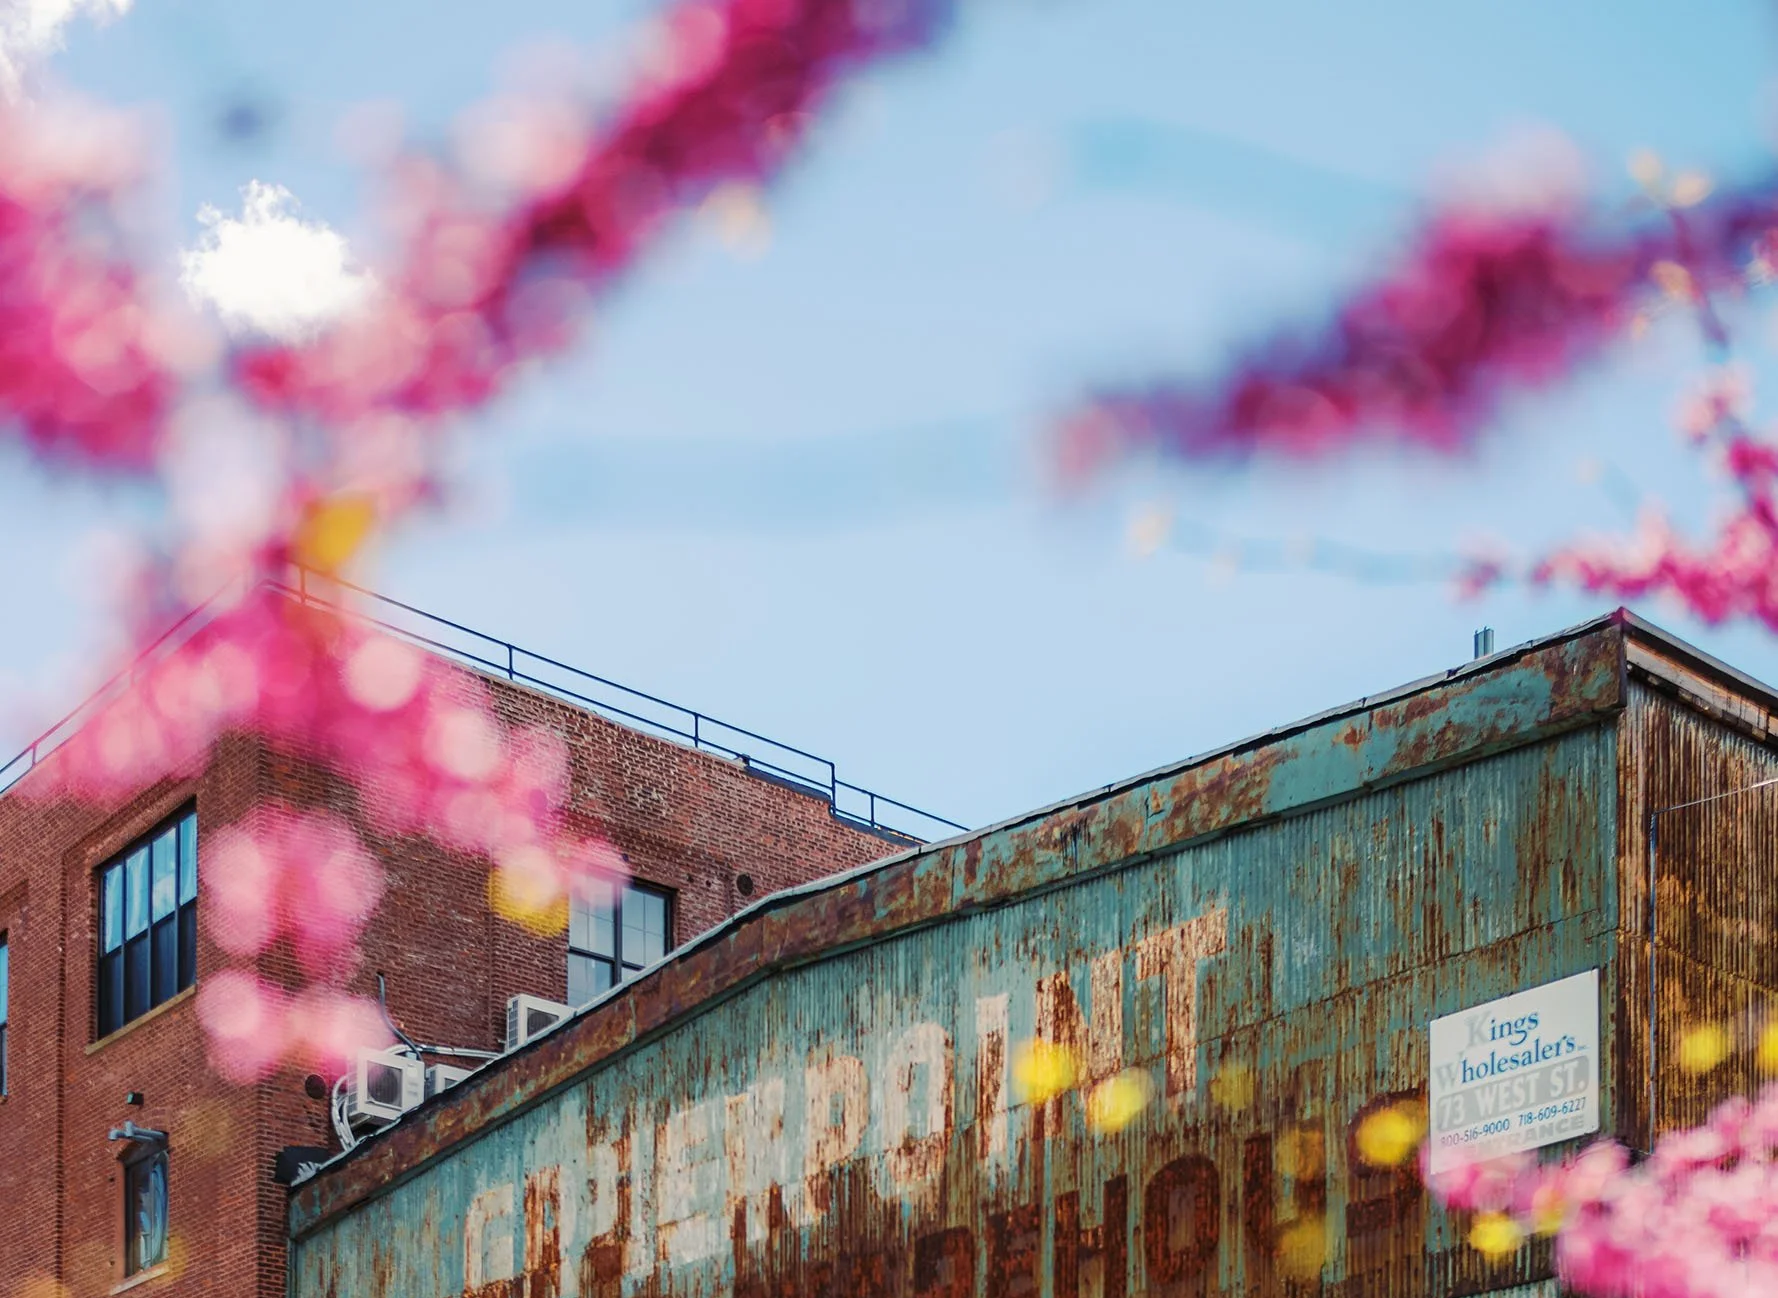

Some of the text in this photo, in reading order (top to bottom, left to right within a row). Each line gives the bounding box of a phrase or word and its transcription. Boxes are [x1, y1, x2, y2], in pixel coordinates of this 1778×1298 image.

[1464, 1010, 1540, 1049] Kings
[1439, 1060, 1585, 1131] 73 WEST ST.
[1518, 1096, 1587, 1127] 718-609-6227
